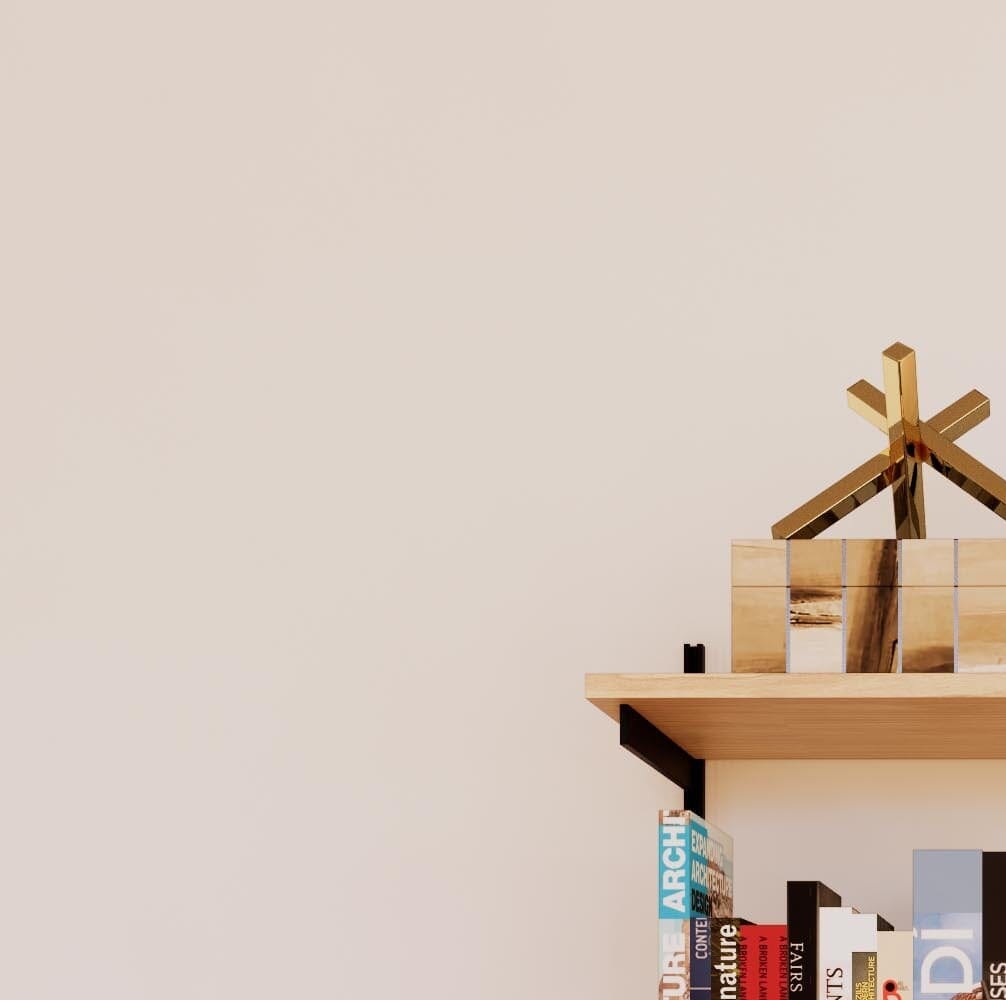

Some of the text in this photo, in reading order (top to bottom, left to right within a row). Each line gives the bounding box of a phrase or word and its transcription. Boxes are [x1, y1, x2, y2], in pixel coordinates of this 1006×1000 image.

[695, 917, 708, 959] CONTE
[759, 944, 768, 979] BROKEN
[778, 944, 787, 979] BROKEN
[790, 942, 804, 992] FAIRS
